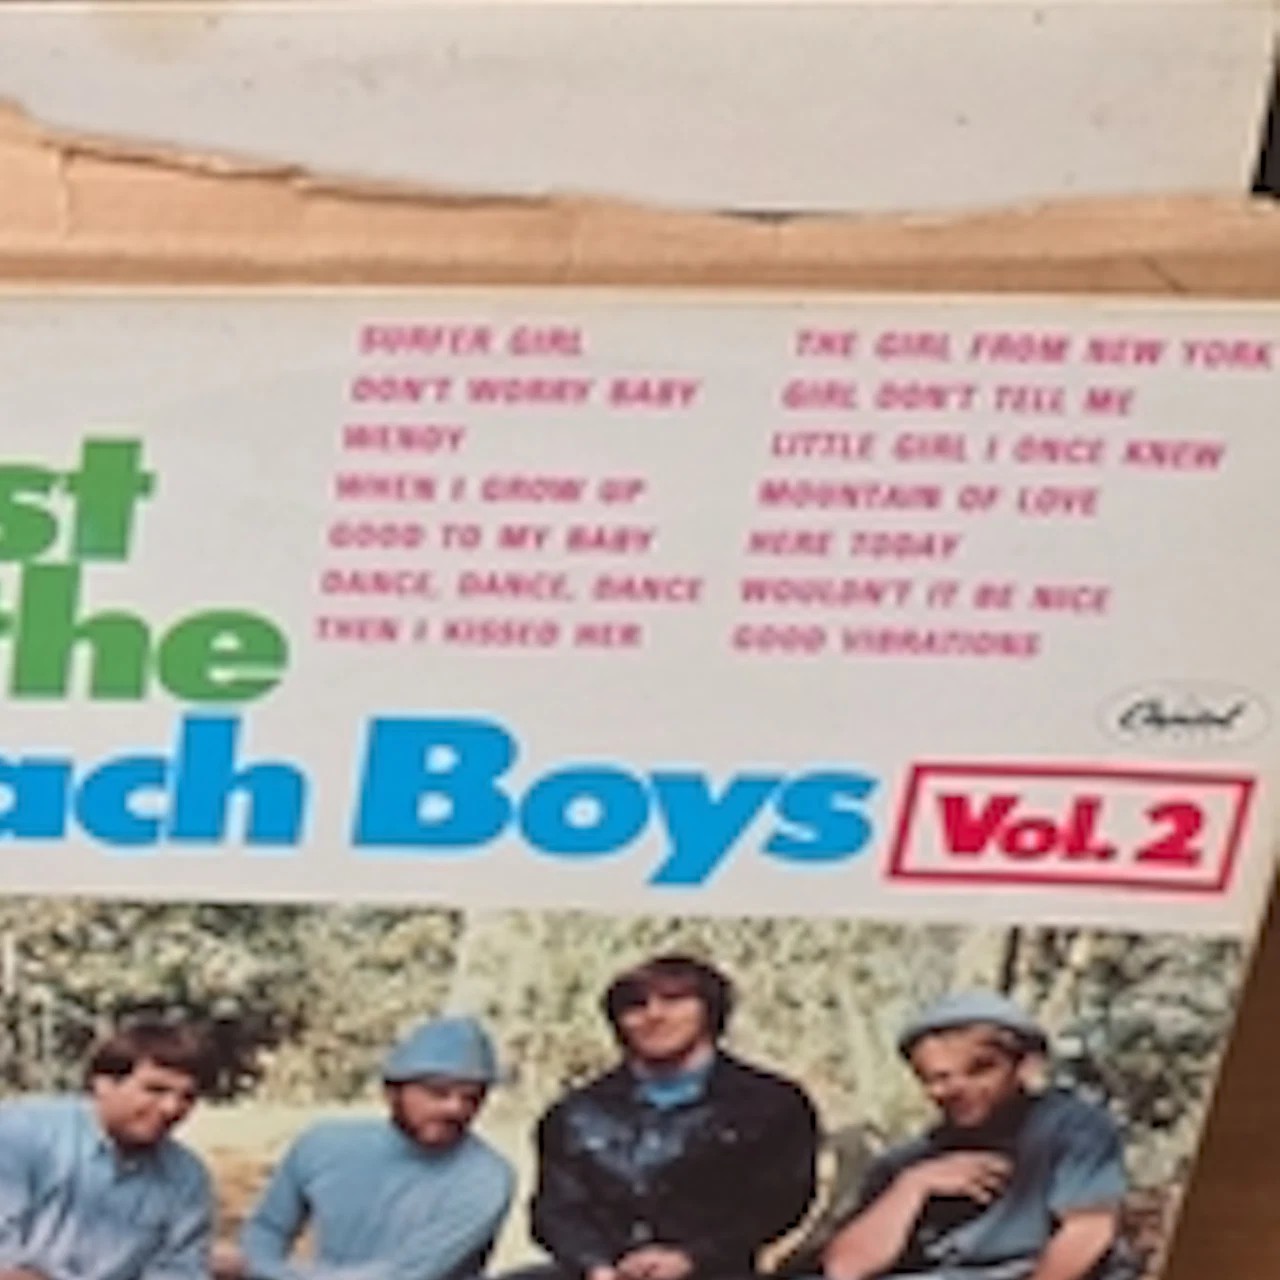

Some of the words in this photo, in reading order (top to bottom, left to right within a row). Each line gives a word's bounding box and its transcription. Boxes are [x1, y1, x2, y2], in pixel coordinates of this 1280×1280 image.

[359, 326, 496, 355] SURFER
[508, 327, 585, 357] GIRL
[797, 327, 860, 359] THE
[876, 329, 955, 361] GIRL
[971, 332, 1071, 364] FROM
[1081, 333, 1168, 365] NEW
[1184, 337, 1274, 369] YORK
[354, 375, 452, 405] DON'T
[467, 378, 591, 405] WORRY
[605, 379, 697, 408] BABY
[784, 380, 859, 409] GIRL
[874, 380, 975, 411] DON'T
[992, 383, 1063, 411] TELL
[1081, 385, 1135, 417] ME
[345, 426, 465, 453] WENDY
[774, 429, 877, 457] LITTLE
[894, 435, 969, 460] GIRL
[1012, 437, 1108, 466] ONCE
[1123, 441, 1222, 469] KNEW
[337, 473, 437, 500] WHEN
[482, 475, 587, 502] GROW
[597, 477, 641, 503] UP
[758, 479, 944, 511] MOUNTAIN
[959, 486, 1003, 512] OF
[1018, 488, 1096, 516] LOVE
[330, 521, 424, 548] GOOD
[437, 523, 480, 548] TO
[497, 524, 549, 549] MY
[564, 525, 650, 552] BABY
[747, 532, 834, 557] HERE
[852, 533, 959, 562] TODAY
[591, 576, 701, 602] DANCE
[740, 578, 910, 607] WOULDN'T
[932, 582, 956, 605] IT
[972, 582, 1018, 610] BE
[1031, 583, 1110, 611] NICE
[316, 617, 402, 642] THEN
[438, 621, 560, 645] KISSED
[574, 624, 640, 647] HER
[732, 626, 825, 653] GOOD
[838, 627, 1039, 657] VIBRATIONS
[350, 717, 882, 888] Boys
[936, 793, 1116, 860] Vol.
[1135, 799, 1204, 868] 2
